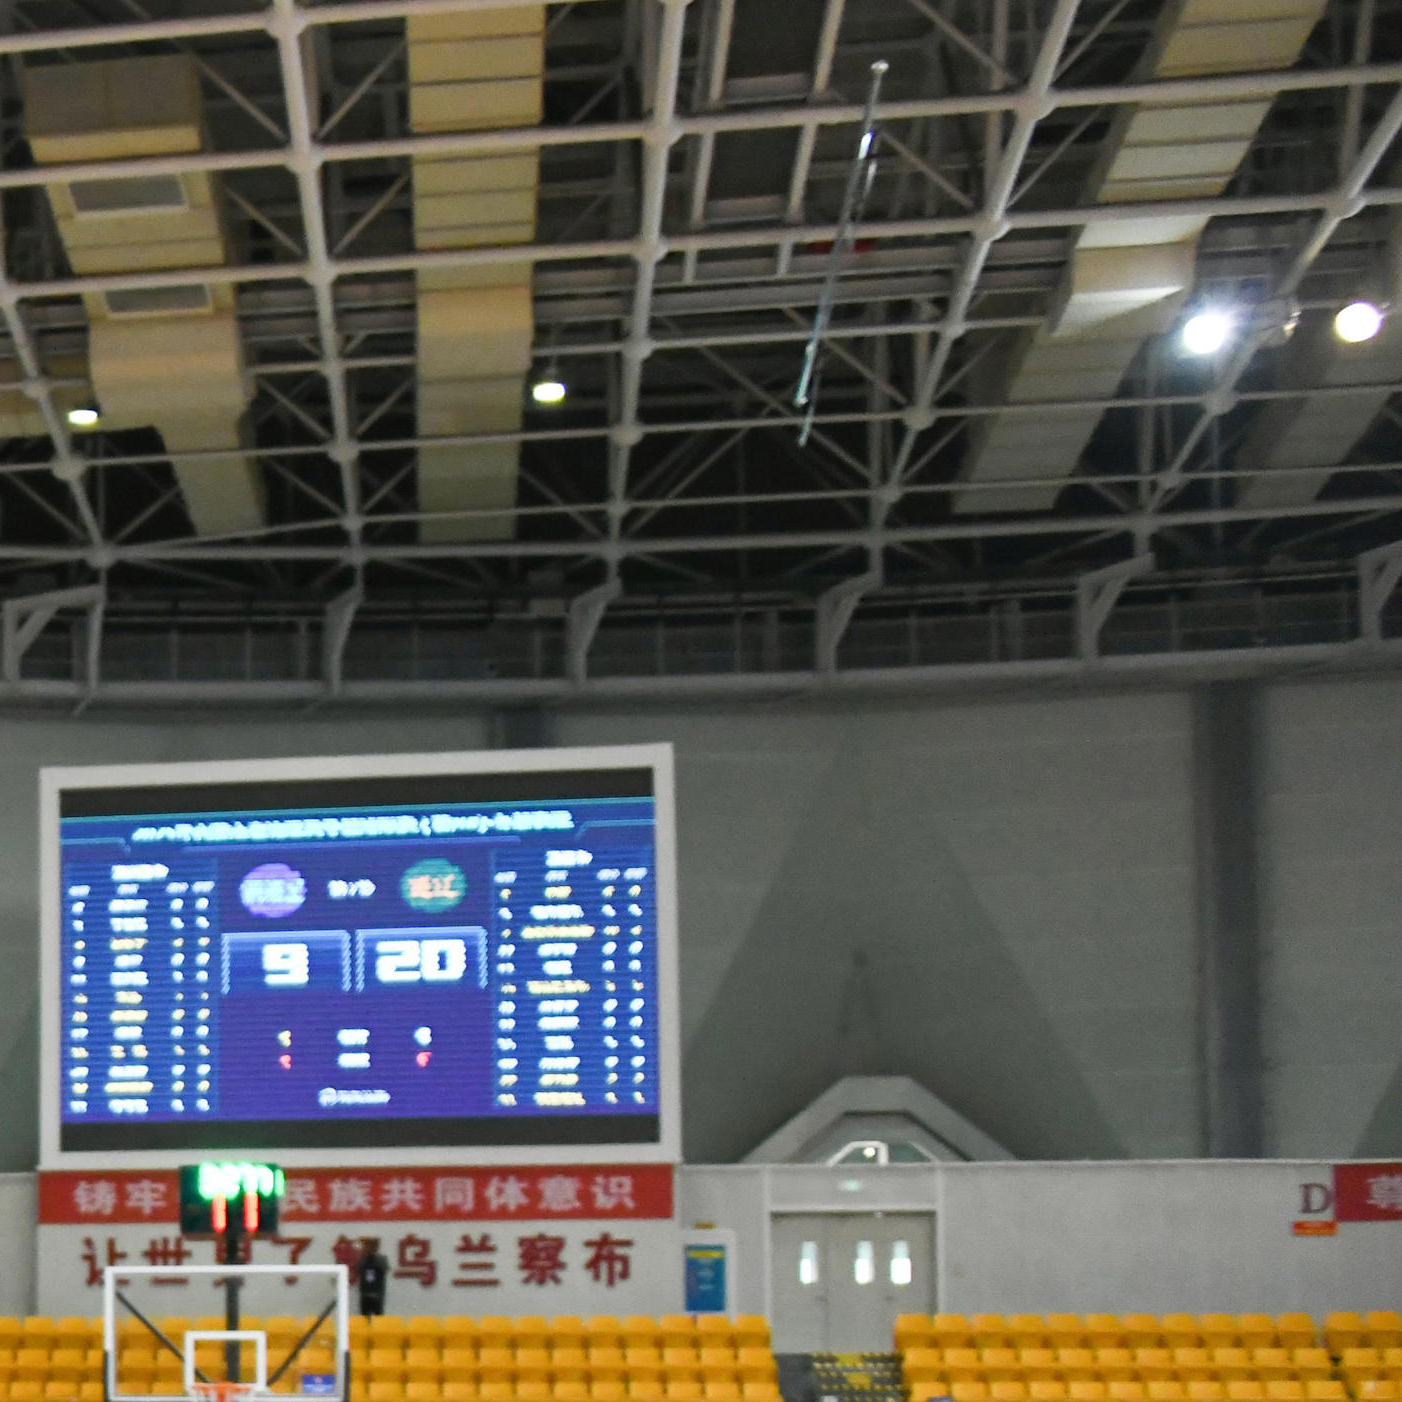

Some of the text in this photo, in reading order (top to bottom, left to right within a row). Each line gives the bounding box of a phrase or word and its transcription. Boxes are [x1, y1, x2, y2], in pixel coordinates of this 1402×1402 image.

[263, 943, 310, 985] 9
[376, 938, 467, 983] 20
[72, 1175, 638, 1214] 铸牢民族共同体意识
[1299, 1182, 1334, 1214] D
